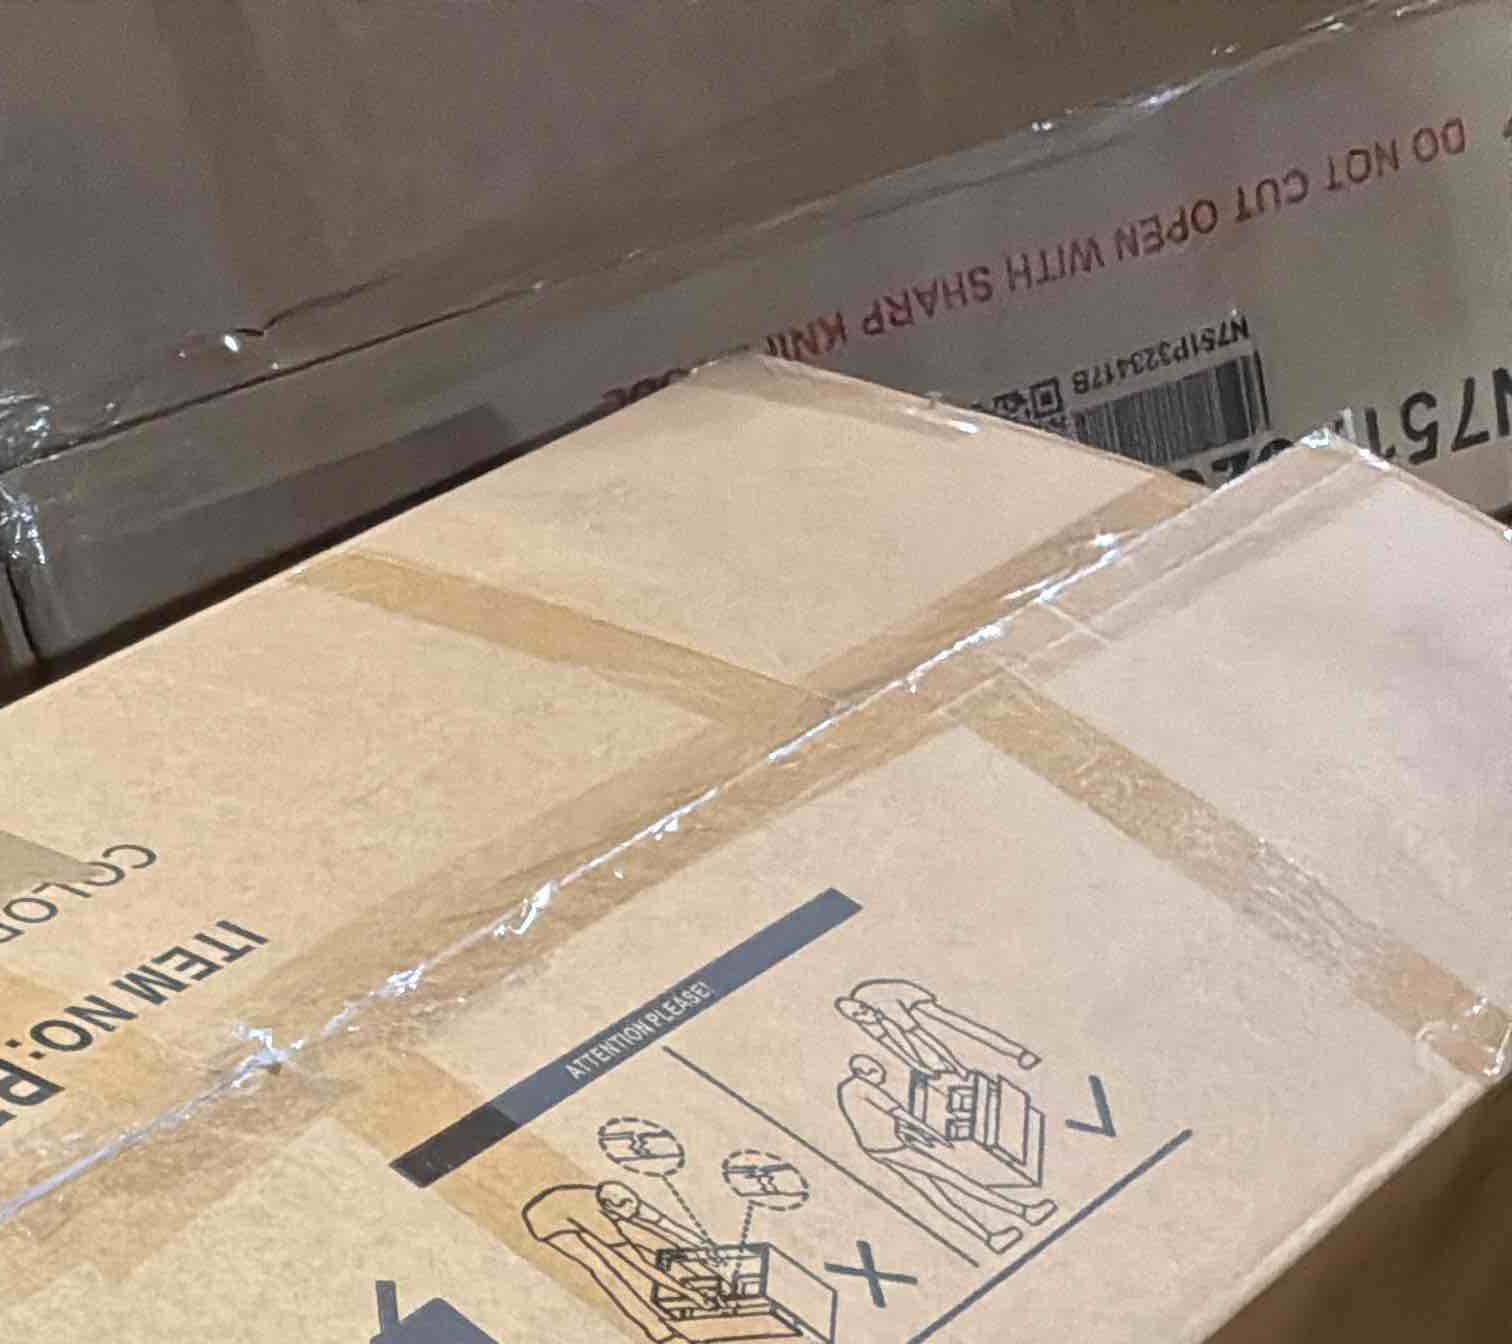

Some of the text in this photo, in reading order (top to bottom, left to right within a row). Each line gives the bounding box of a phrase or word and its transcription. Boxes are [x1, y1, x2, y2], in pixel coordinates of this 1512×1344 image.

[1324, 139, 1400, 192] NOT
[1412, 118, 1466, 162] DO
[1234, 166, 1310, 222] CUT
[1116, 198, 1220, 264] OPEN
[1006, 234, 1106, 292] WITH
[860, 264, 994, 338] SHARP
[111, 919, 269, 1005] ITEM
[565, 1018, 652, 1080] ATTENTION
